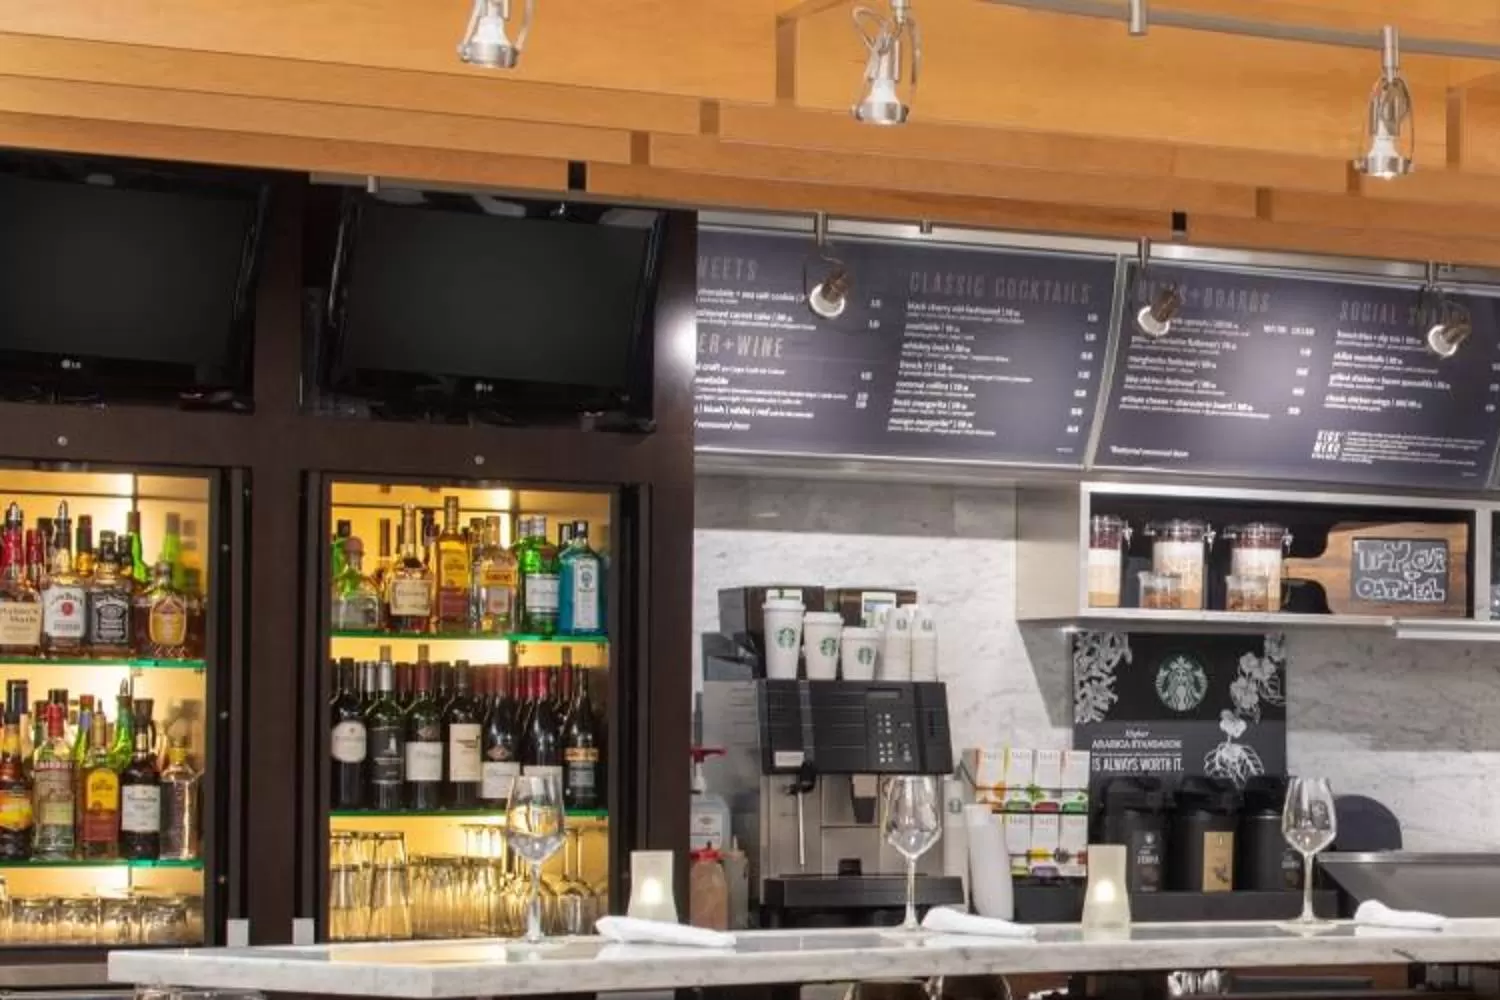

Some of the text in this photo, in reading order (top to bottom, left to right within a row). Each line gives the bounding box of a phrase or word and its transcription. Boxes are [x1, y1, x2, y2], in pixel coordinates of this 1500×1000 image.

[995, 276, 1093, 304] COCKTAILS
[1103, 757, 1139, 772] ALWAYS
[1140, 757, 1172, 772] WORTH
